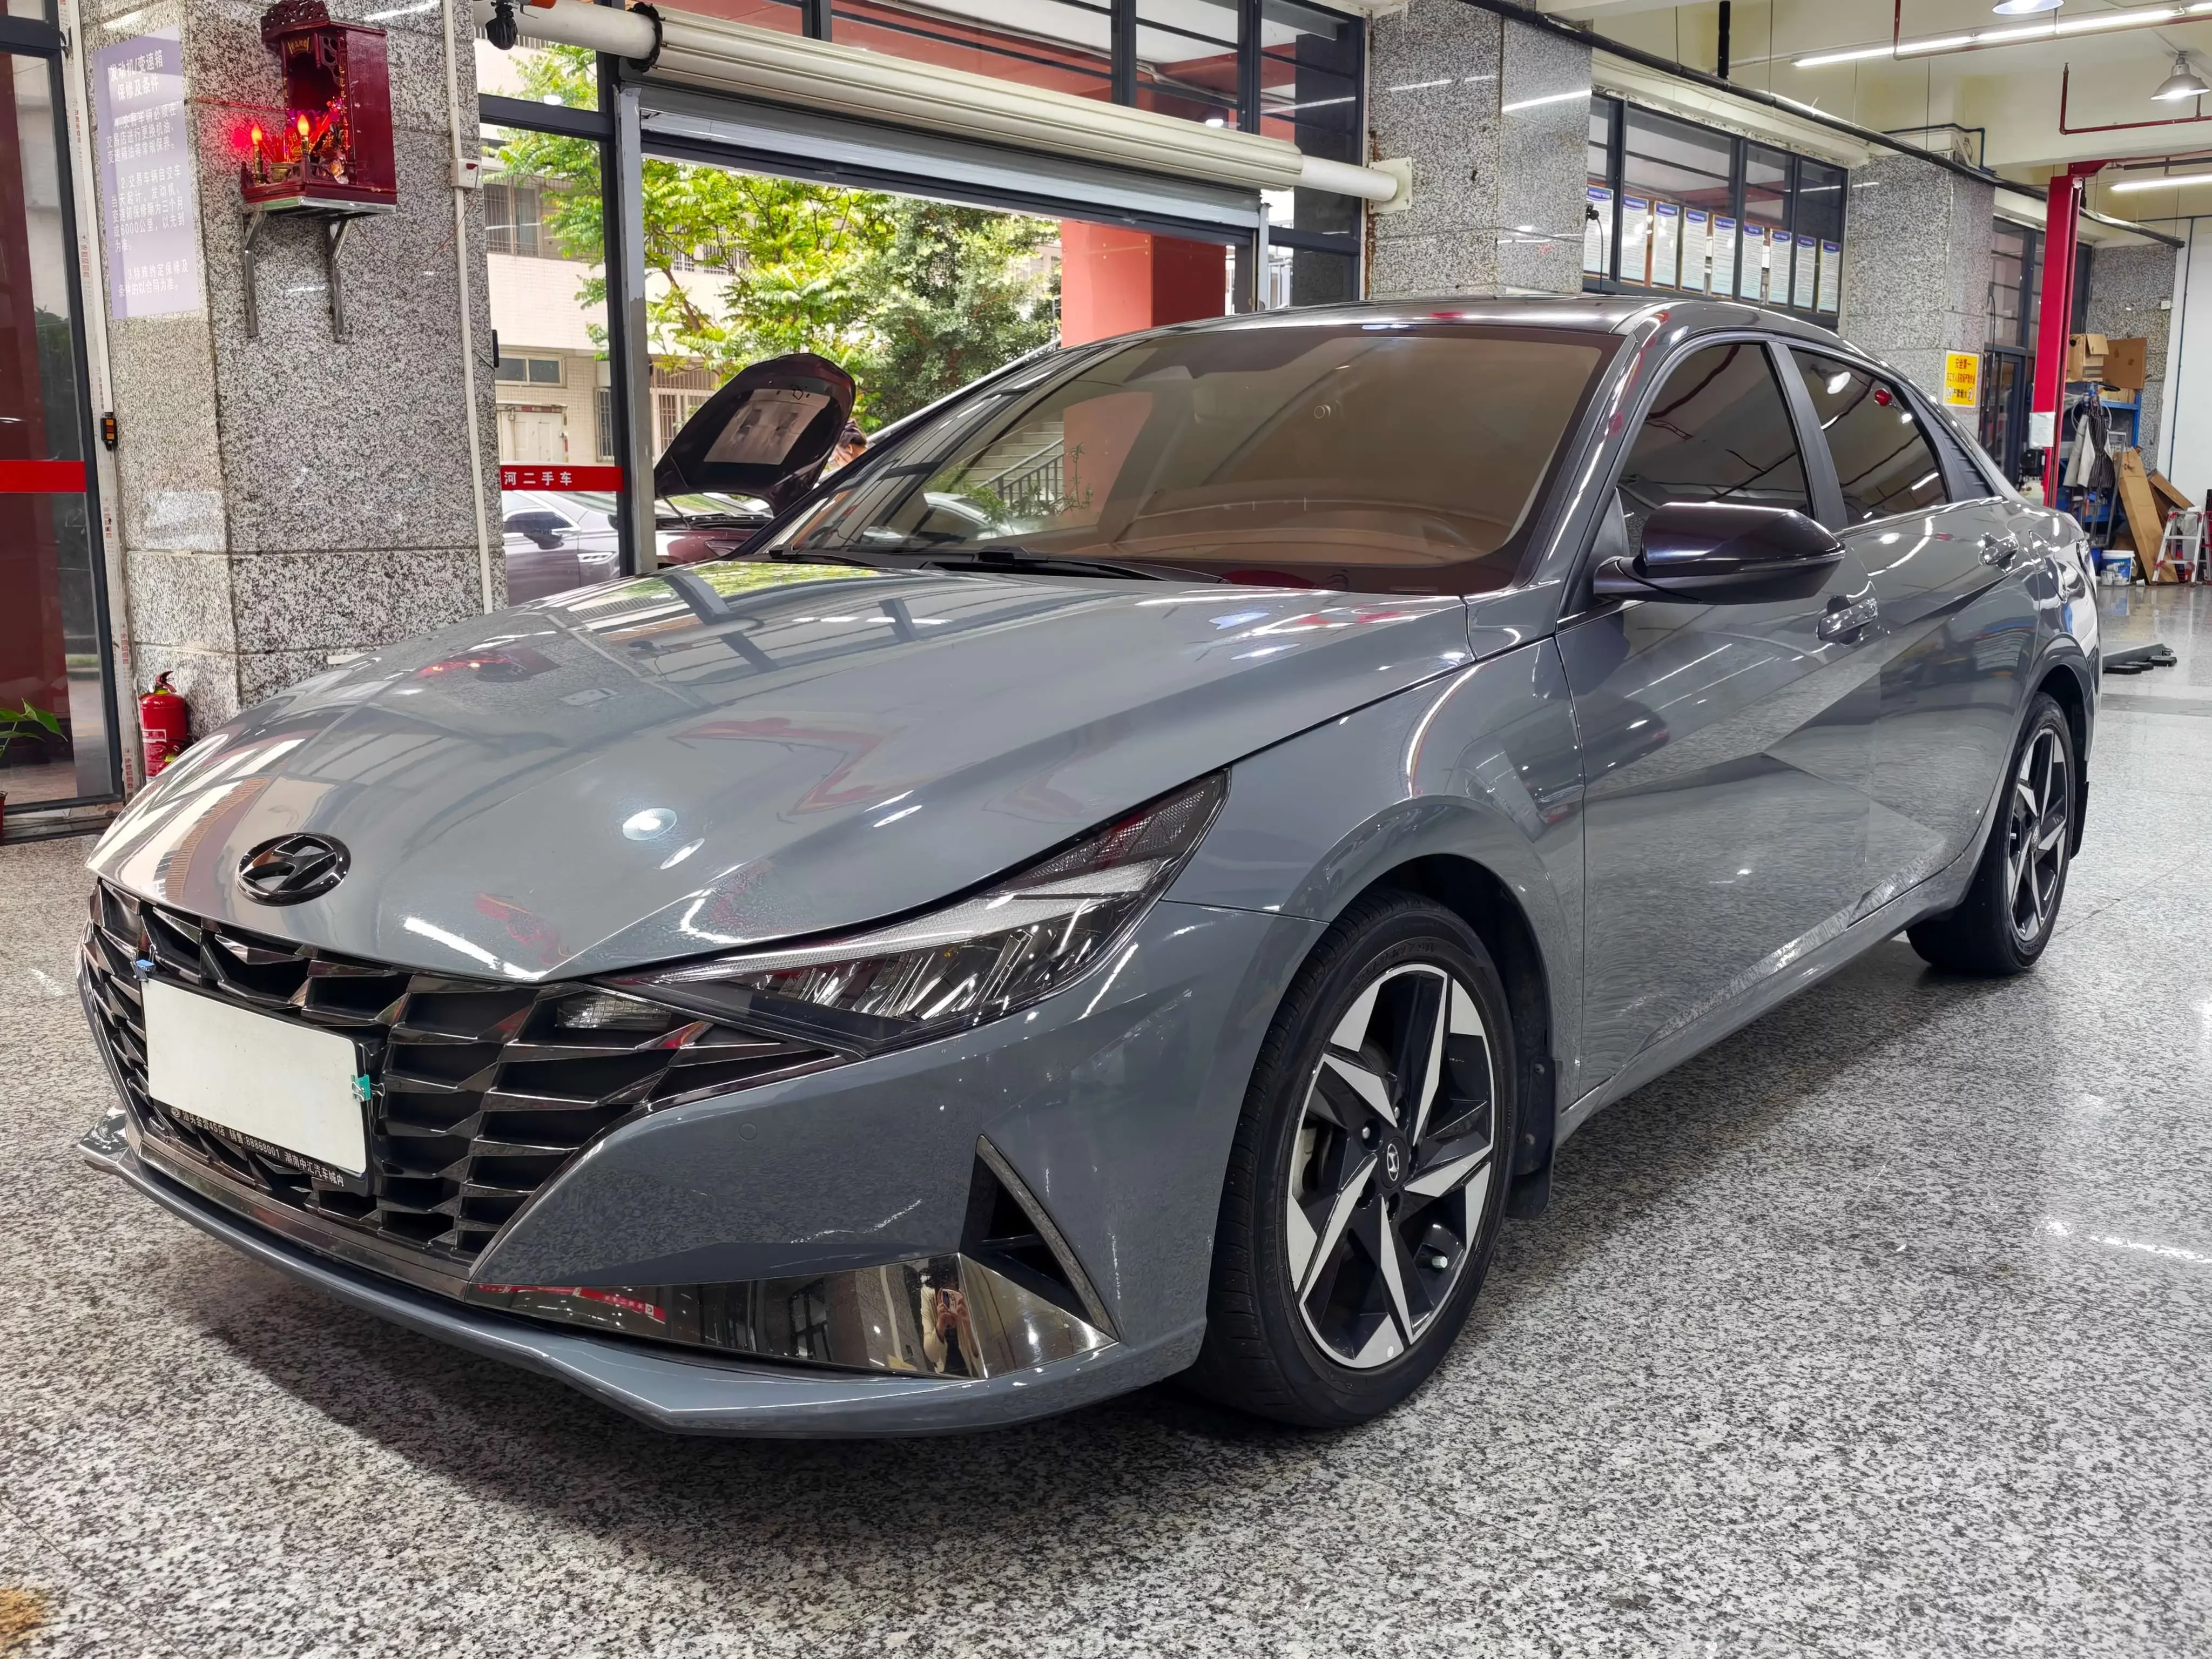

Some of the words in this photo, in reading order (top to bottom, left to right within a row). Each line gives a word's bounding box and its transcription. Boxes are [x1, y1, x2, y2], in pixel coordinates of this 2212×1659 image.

[110, 49, 163, 82] 发动机/变速箱
[117, 74, 159, 102] 保修及条件
[121, 165, 181, 188] 2.交易车辆自交车
[504, 471, 572, 486] 河二手车
